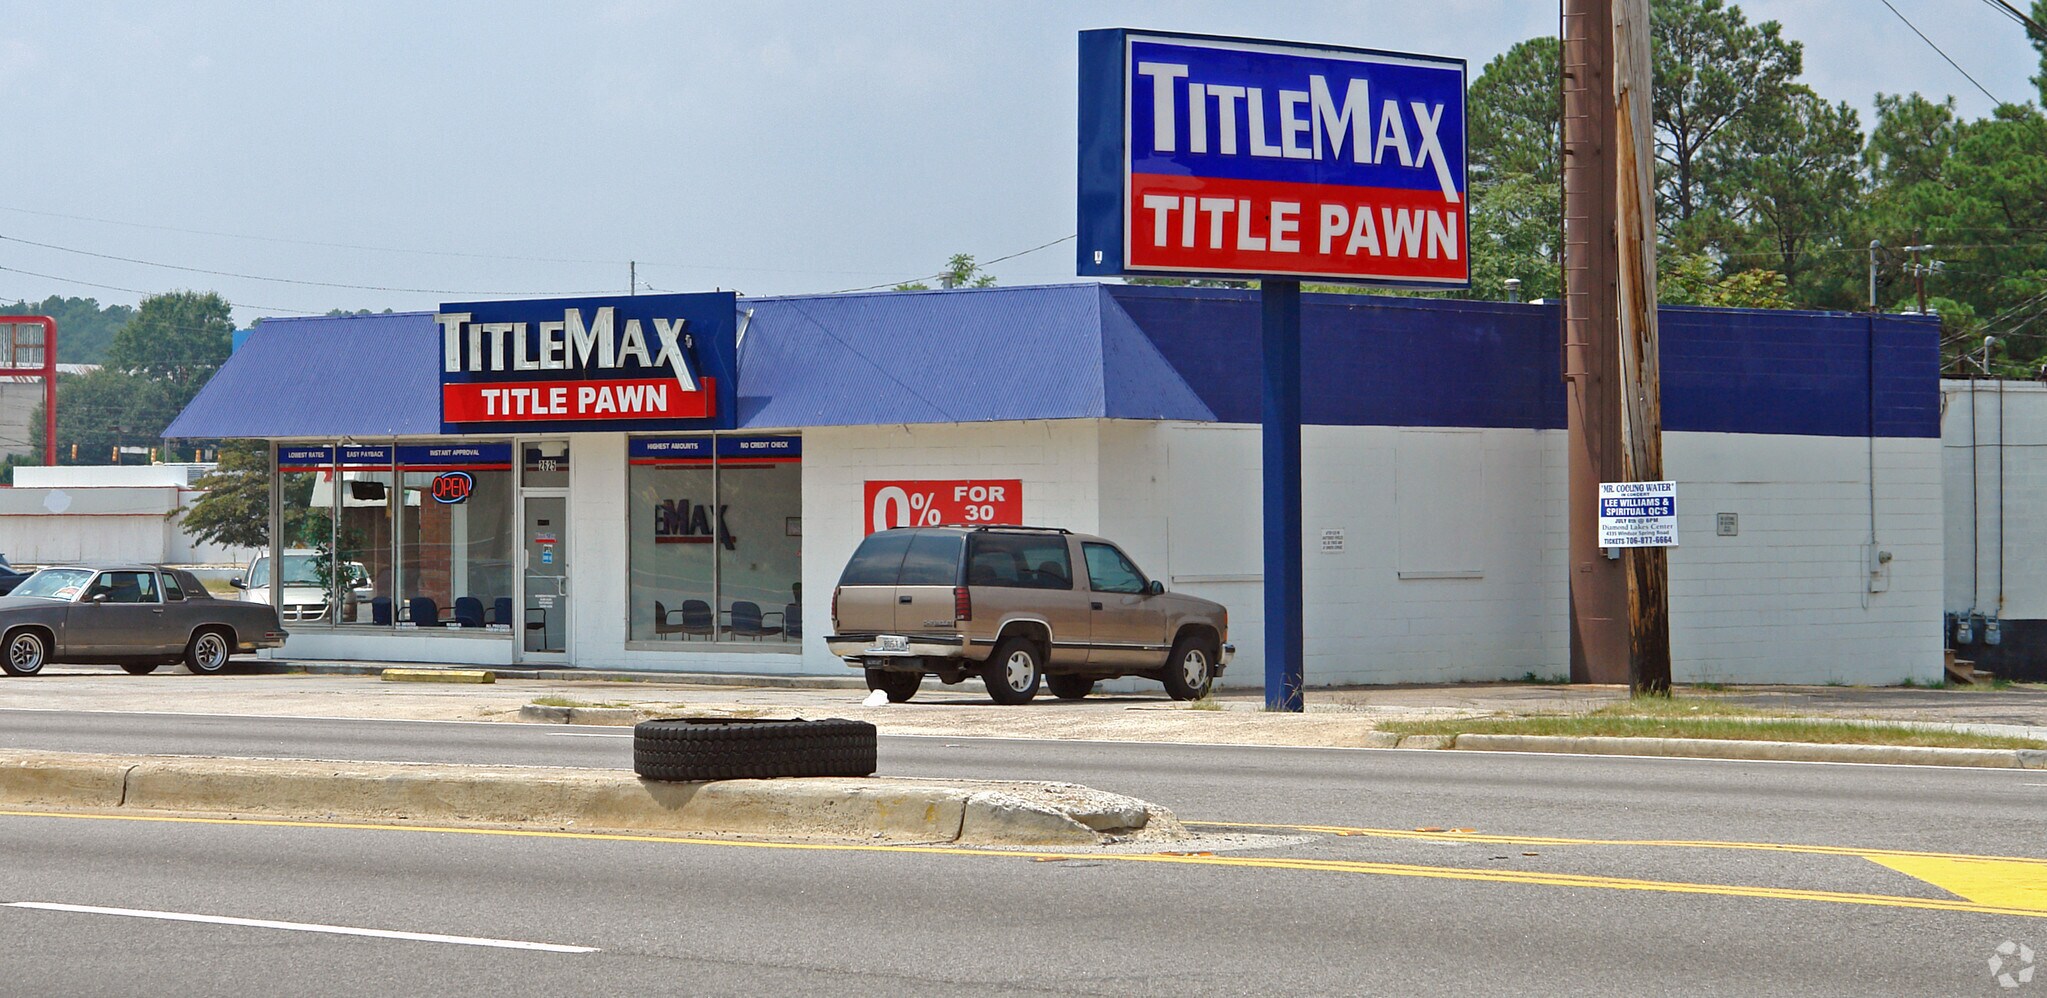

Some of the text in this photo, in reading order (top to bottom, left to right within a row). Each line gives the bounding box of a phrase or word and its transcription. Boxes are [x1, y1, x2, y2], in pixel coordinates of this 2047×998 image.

[1138, 61, 1460, 203] TITLEMAX
[1143, 194, 1458, 261] TITLE PAWN
[433, 306, 698, 391] TITLEMAX
[481, 384, 667, 415] TITLE PAWN
[433, 477, 469, 497] OPEN
[1604, 498, 1669, 507] LEE WILLIAMS &
[873, 486, 1005, 533] 0% FOR
[964, 504, 994, 521] 30
[1606, 507, 1668, 516] SPIRITUAL QC'S
